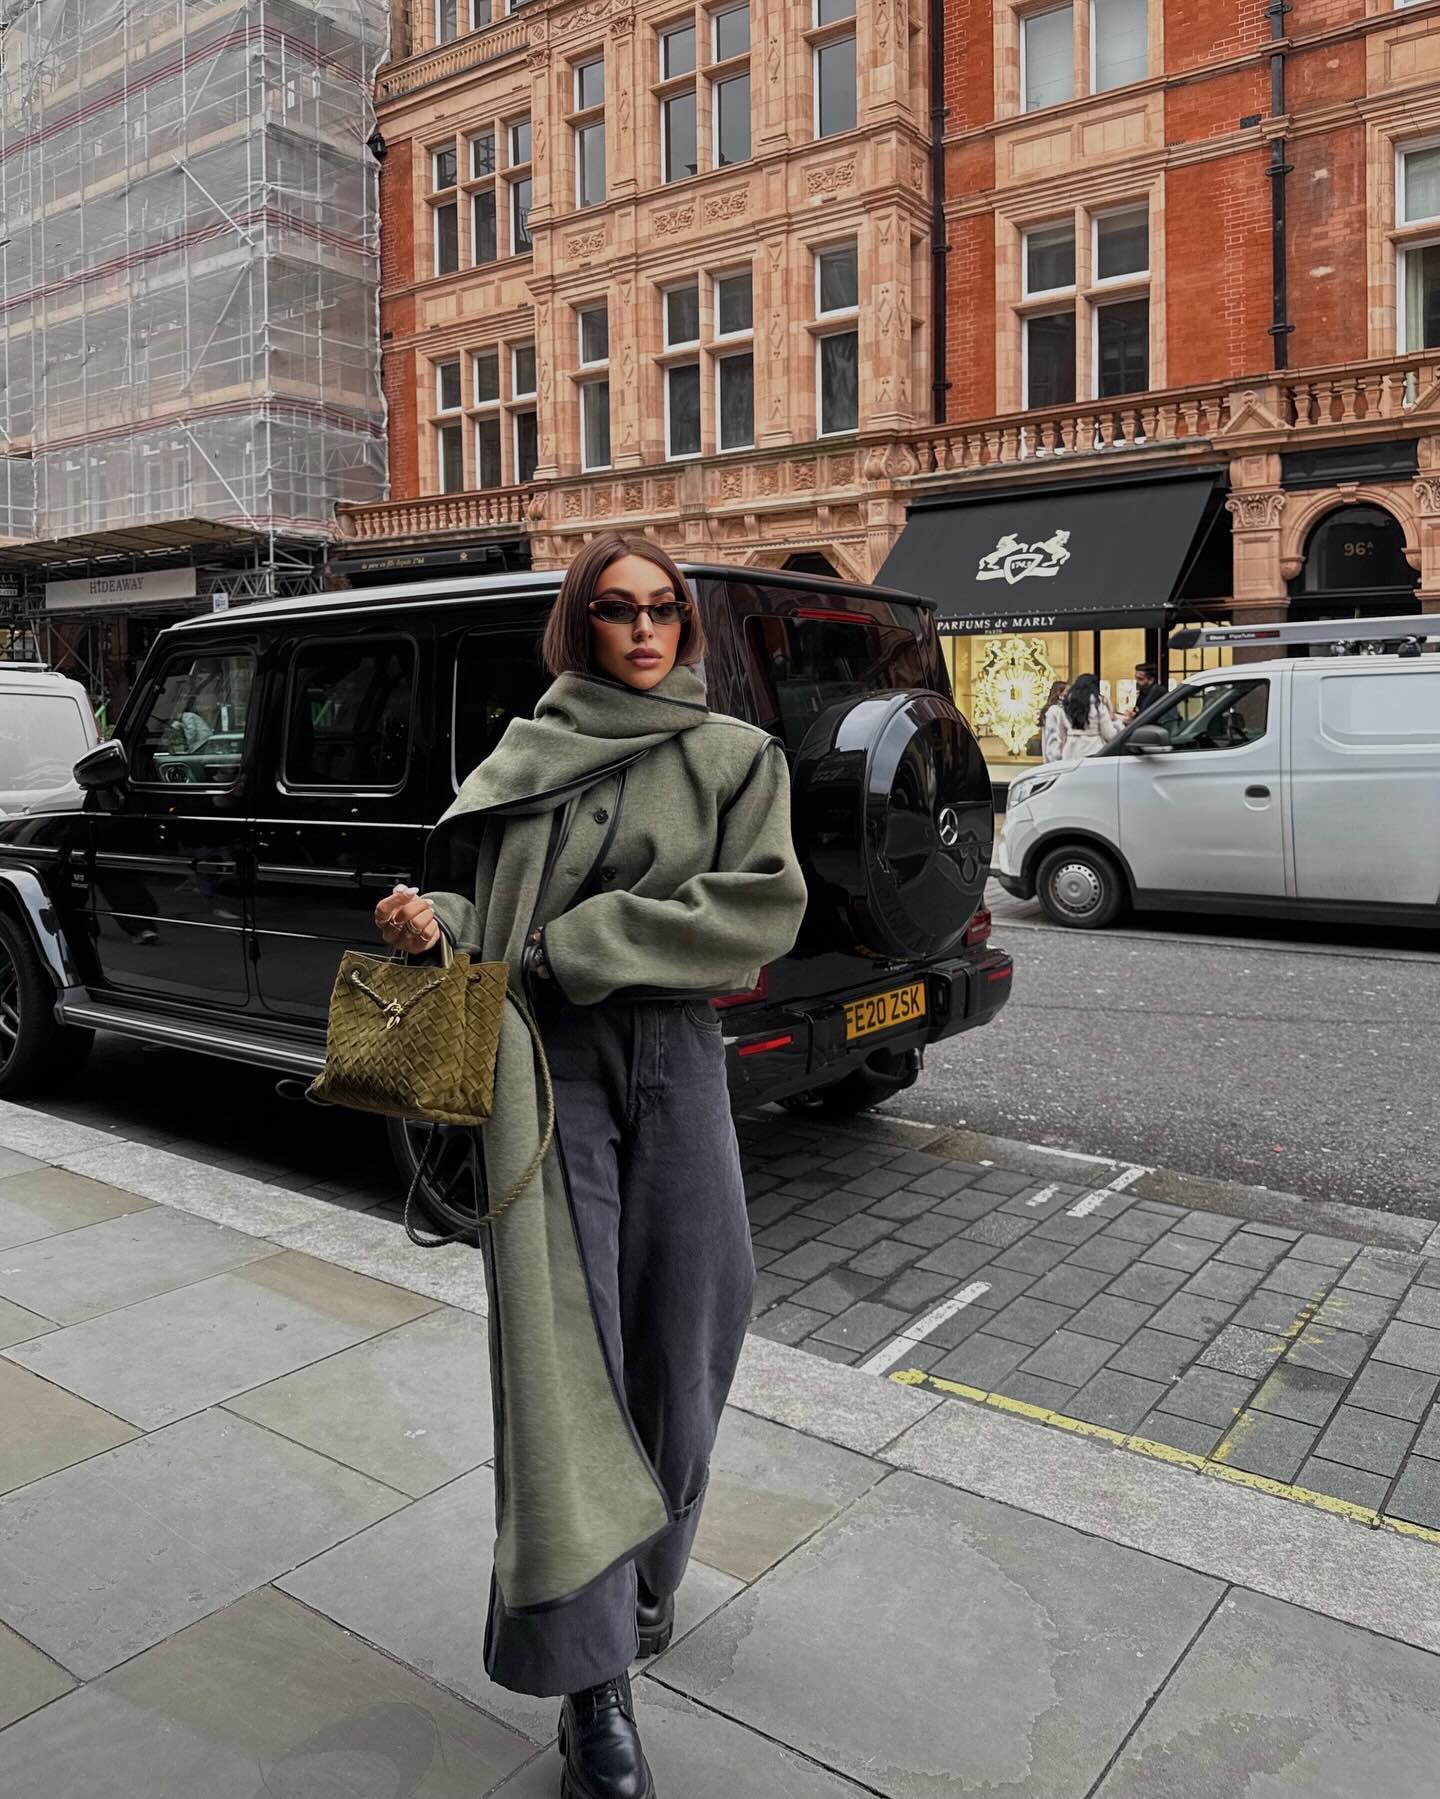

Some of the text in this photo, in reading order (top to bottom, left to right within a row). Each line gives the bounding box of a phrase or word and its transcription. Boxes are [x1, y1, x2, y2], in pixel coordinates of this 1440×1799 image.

[89, 577, 144, 594] HIDEAWAY
[936, 616, 1056, 631] PARFUMS de MARLY
[890, 985, 920, 1021] ZSK
